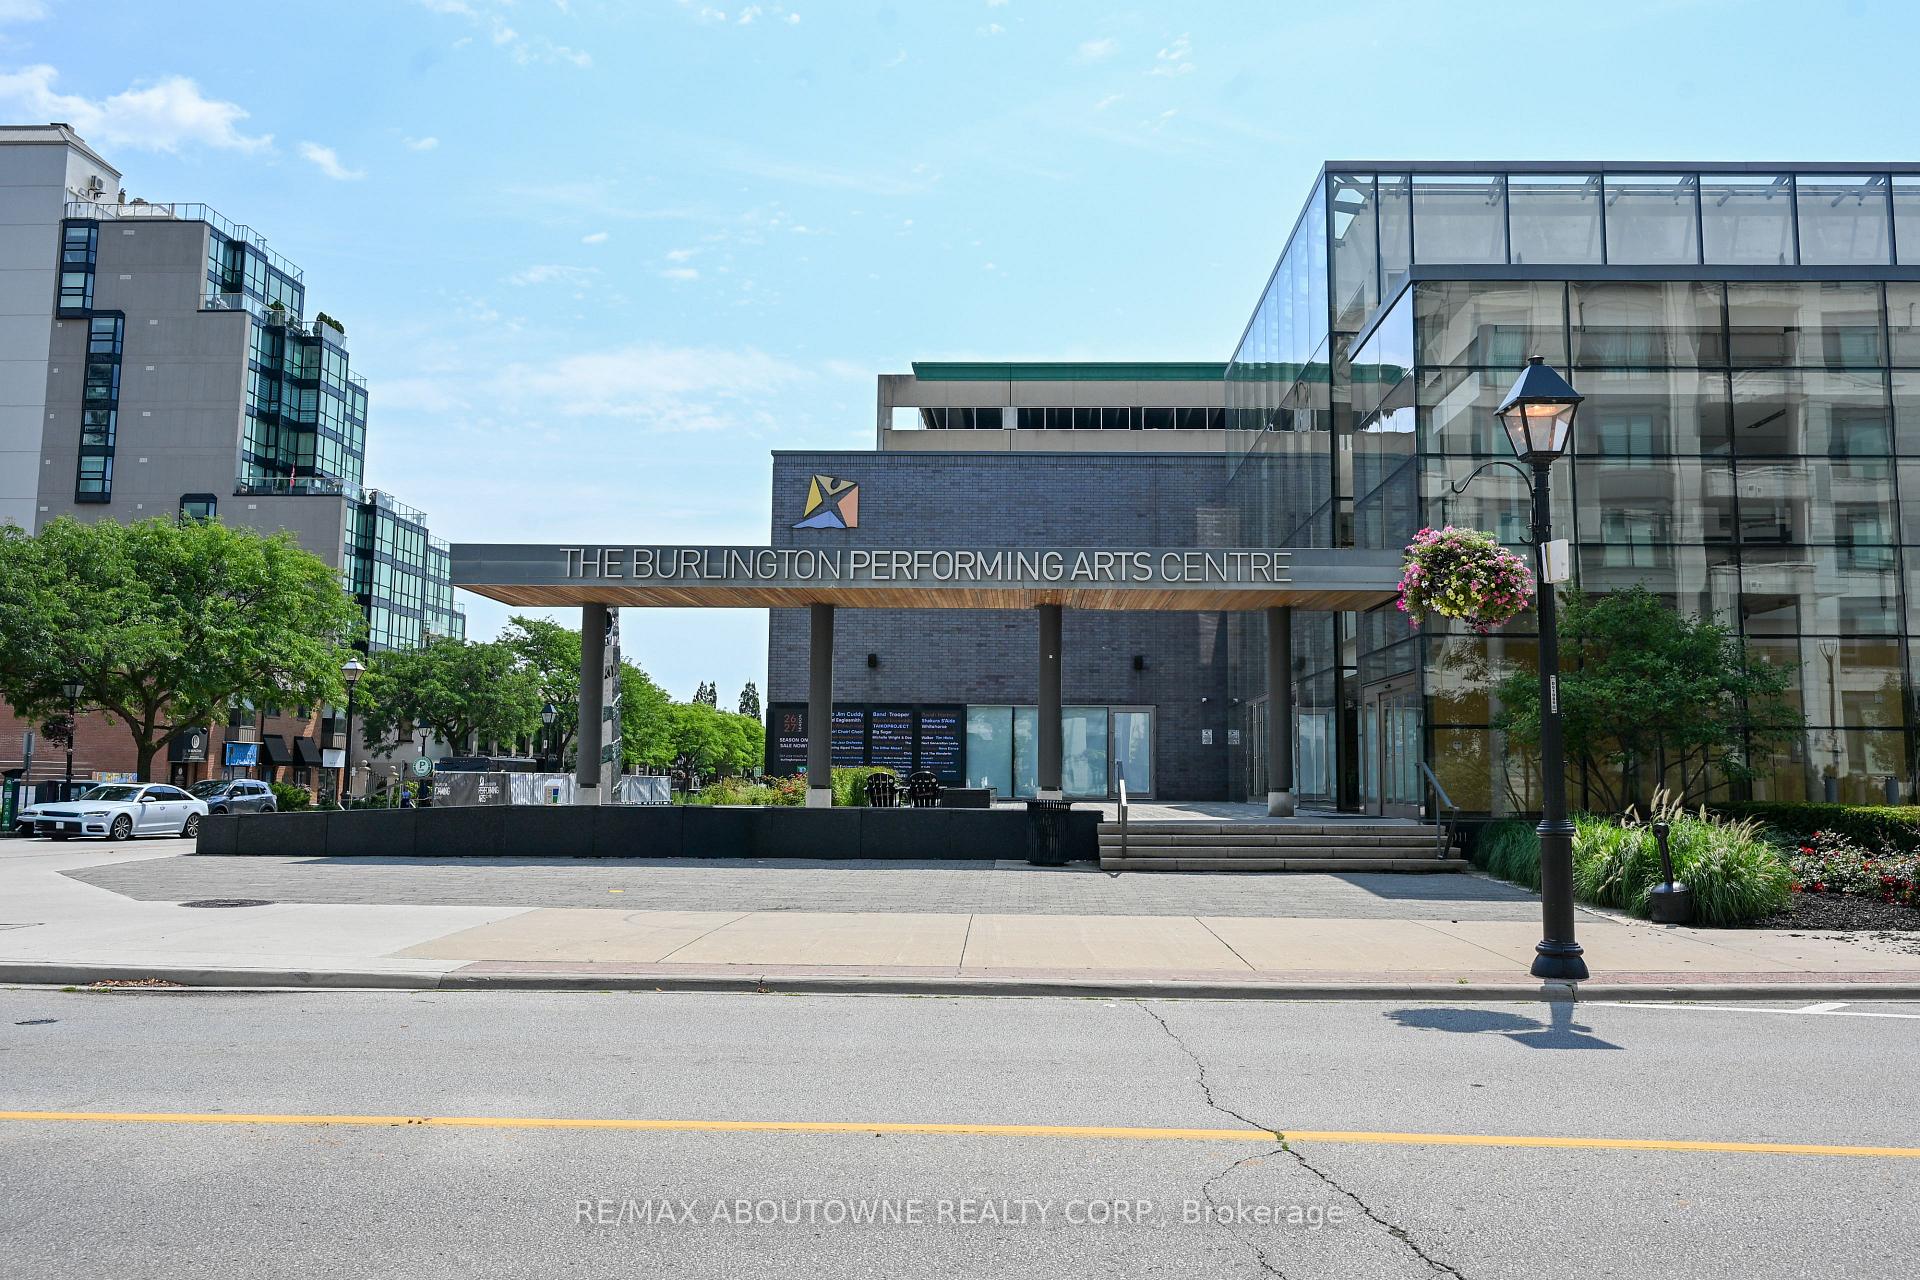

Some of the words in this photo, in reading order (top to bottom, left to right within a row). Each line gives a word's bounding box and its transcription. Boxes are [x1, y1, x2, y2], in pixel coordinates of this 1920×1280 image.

[559, 548, 624, 579] THE
[632, 548, 841, 580] BURLINGTON
[850, 550, 1064, 582] PERFORMING
[1071, 551, 1153, 582] ARTS
[1160, 551, 1292, 583] CENTRE
